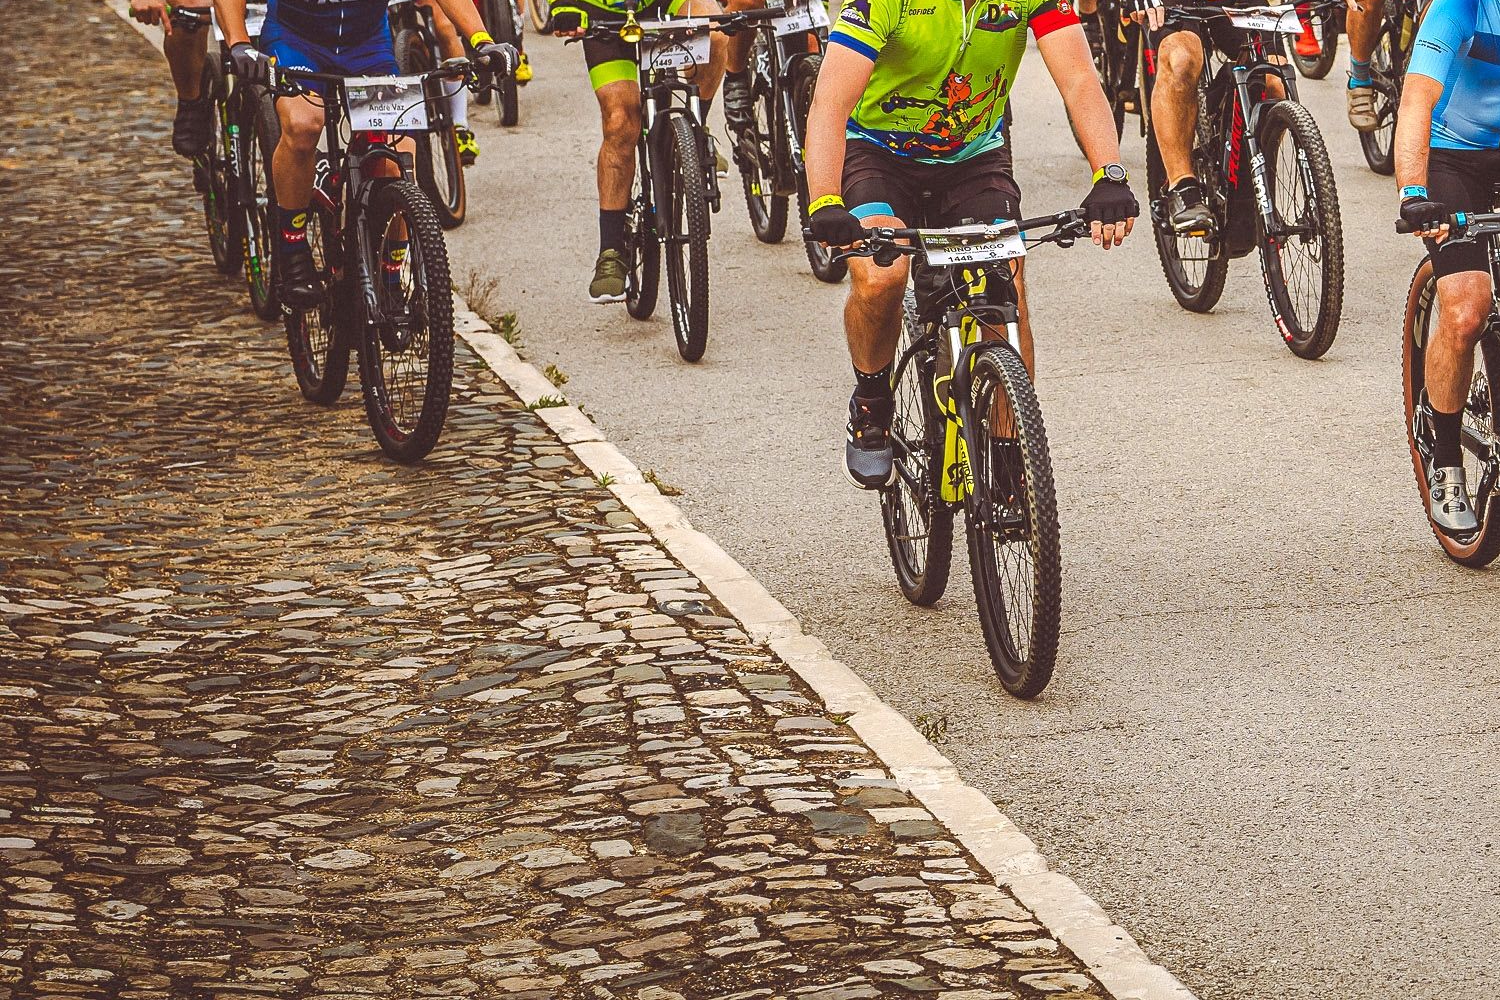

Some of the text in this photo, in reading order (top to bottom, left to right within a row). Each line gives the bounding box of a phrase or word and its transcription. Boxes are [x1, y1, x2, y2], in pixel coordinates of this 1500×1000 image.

[908, 6, 936, 16] COFIDES
[787, 22, 799, 31] 338
[655, 58, 673, 67] 1449
[368, 118, 383, 127] 158
[974, 243, 1005, 251] TIAGO
